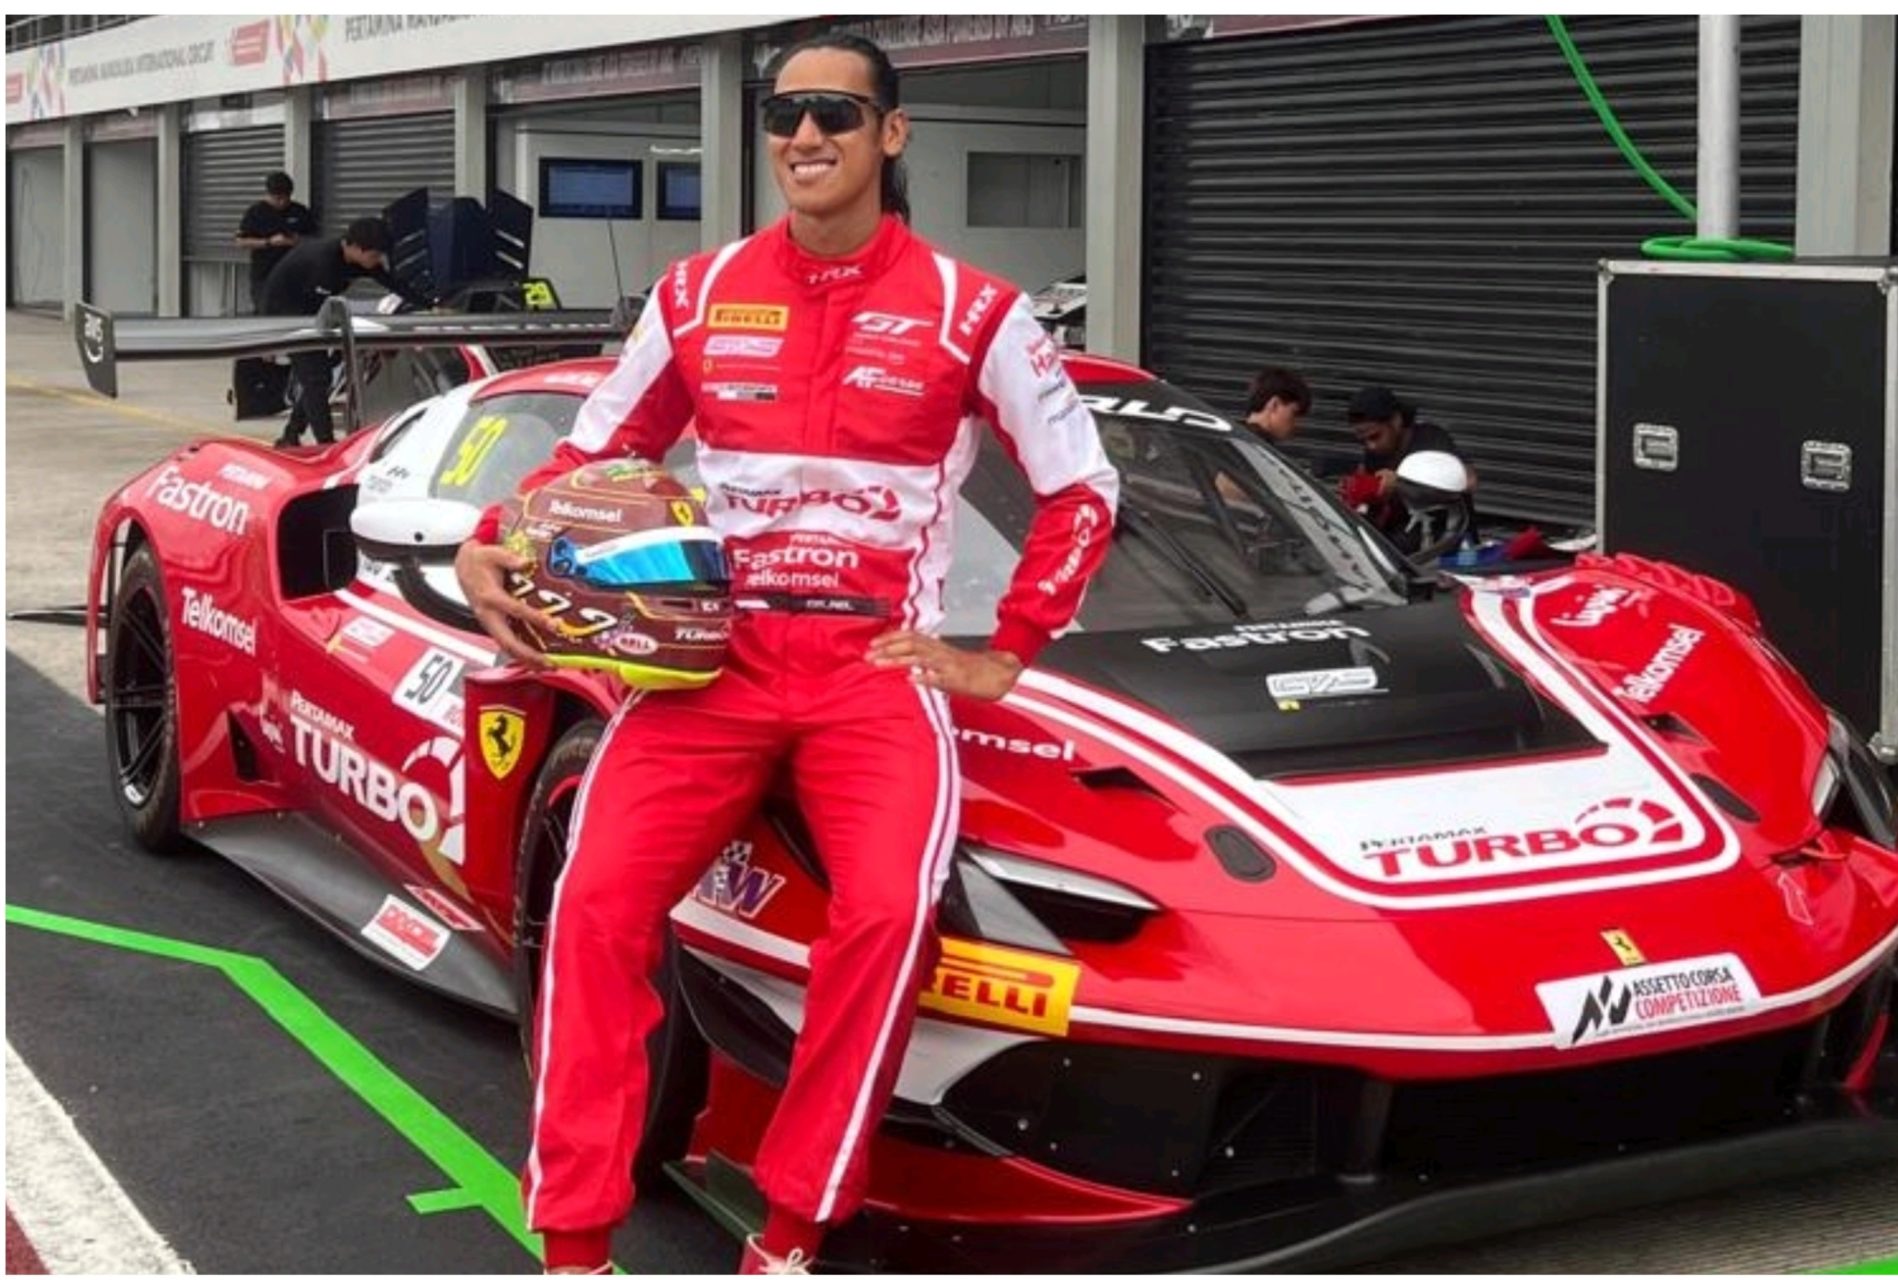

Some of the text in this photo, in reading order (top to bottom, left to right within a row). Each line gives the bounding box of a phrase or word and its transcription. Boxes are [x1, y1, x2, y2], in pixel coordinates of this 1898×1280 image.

[440, 415, 507, 486] 50
[149, 464, 250, 536] Fastron
[725, 489, 873, 519] TURBO
[733, 545, 860, 571] Fastron
[181, 586, 257, 657] Telkomsel
[1140, 626, 1371, 653] Fastron
[402, 653, 453, 705] 50
[289, 689, 355, 741] PERTAMAX
[289, 712, 439, 842] TURBO
[1362, 821, 1639, 877] TURBO
[941, 974, 1047, 1018] ELLI
[1632, 966, 1735, 997] ASSETTO CORSA
[1634, 983, 1742, 1020] COMPETIZIONE
